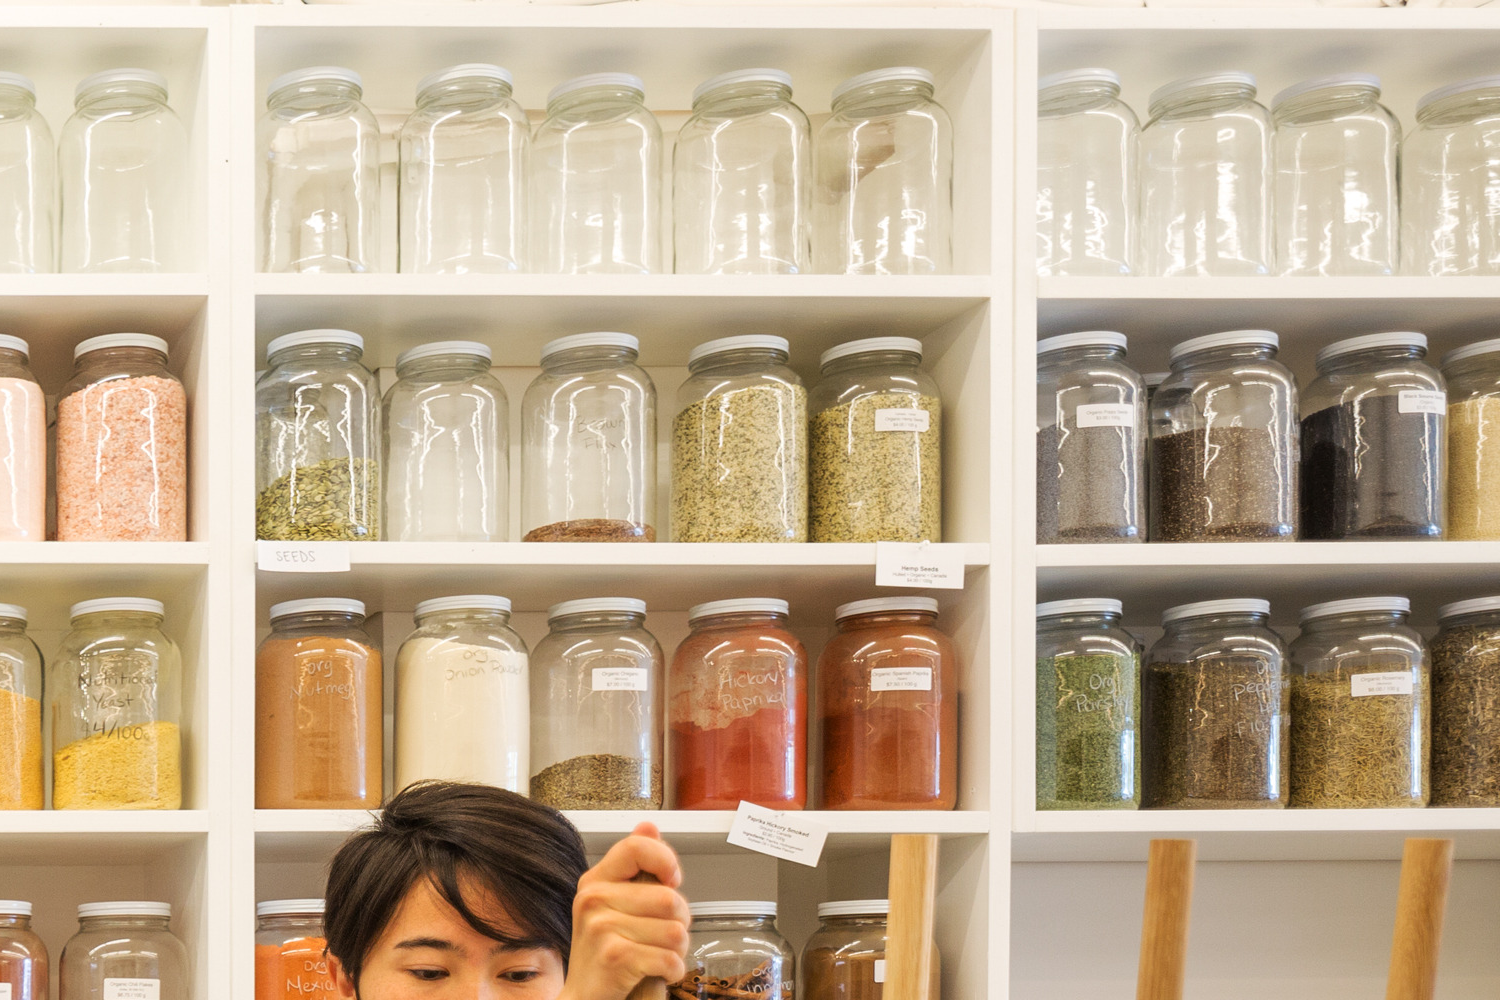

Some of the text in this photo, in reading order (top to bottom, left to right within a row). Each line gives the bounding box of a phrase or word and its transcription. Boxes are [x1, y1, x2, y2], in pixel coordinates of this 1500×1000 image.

[276, 550, 316, 563] SEEDS
[902, 565, 919, 573] Hemp
[307, 660, 334, 679] org
[720, 670, 779, 689] Hickory
[1089, 673, 1116, 694] Org
[289, 681, 352, 701] Nutmeg
[92, 693, 135, 711] Yeast
[720, 693, 784, 712] Paprika
[747, 814, 810, 838] Paprika Hickory Smoked
[304, 960, 329, 975] Org
